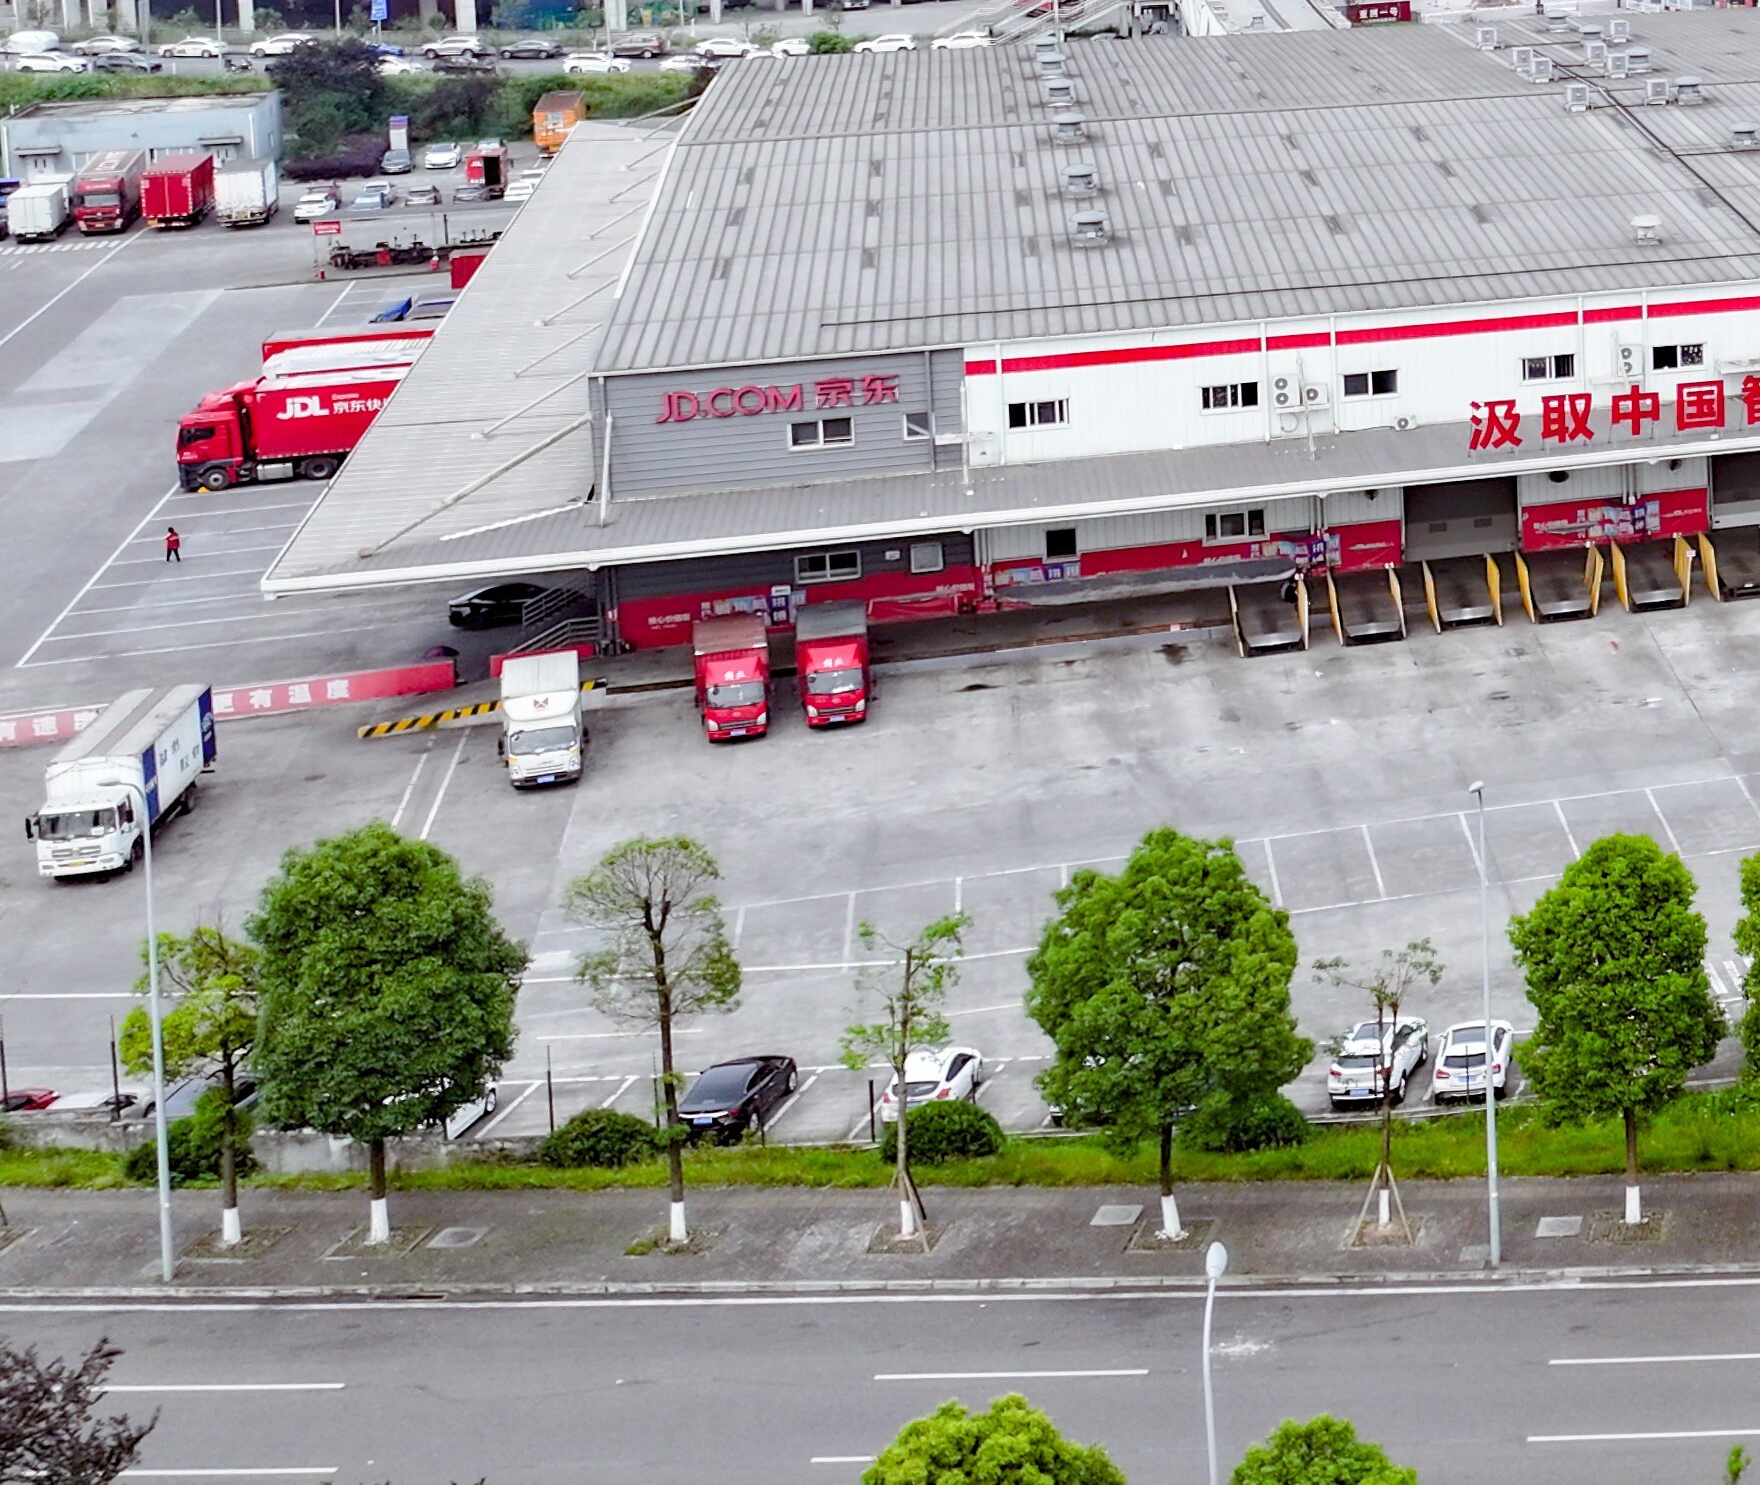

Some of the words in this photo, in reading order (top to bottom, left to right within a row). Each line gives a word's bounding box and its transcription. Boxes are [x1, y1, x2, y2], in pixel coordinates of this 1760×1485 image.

[276, 395, 330, 420] JDL
[655, 382, 804, 424] JD.COM
[814, 374, 900, 409] 京东
